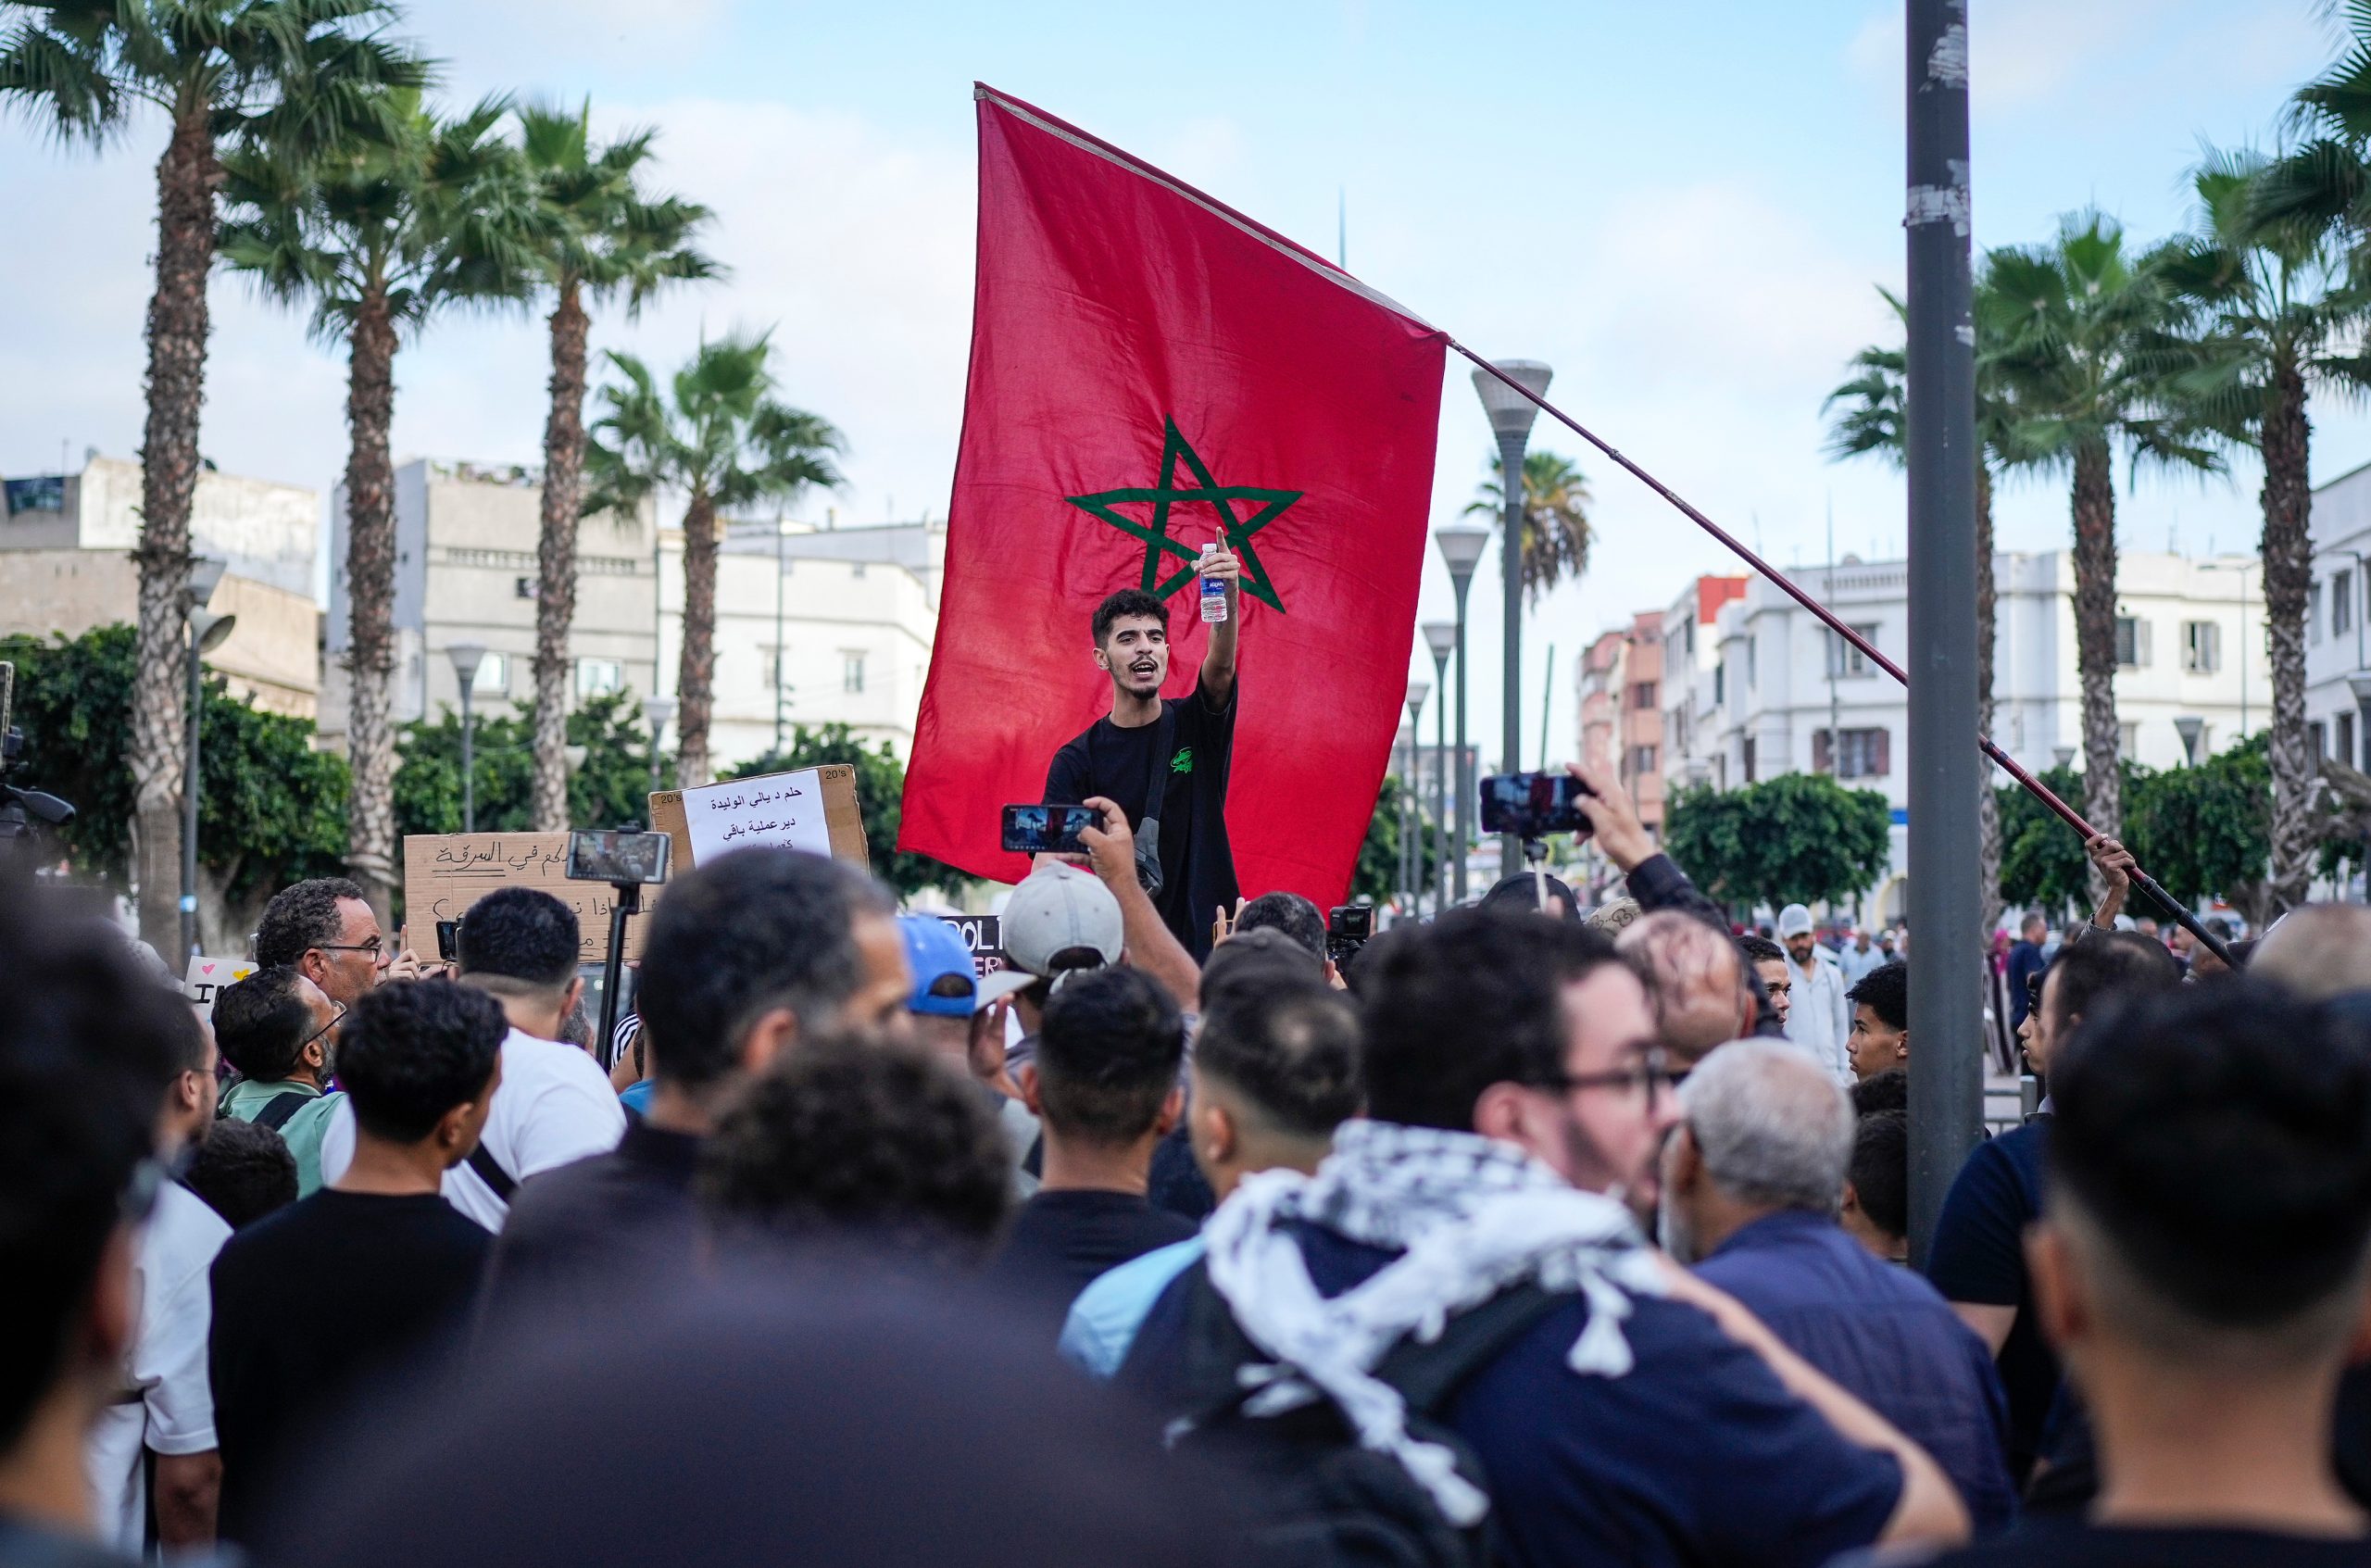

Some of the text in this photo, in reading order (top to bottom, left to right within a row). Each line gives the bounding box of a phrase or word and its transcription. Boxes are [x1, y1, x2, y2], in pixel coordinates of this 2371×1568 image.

[825, 769, 847, 780] 20's
[660, 794, 683, 804] 20's
[784, 786, 802, 802] حلم
[710, 795, 745, 810] الوليدة
[722, 823, 746, 842] باقي
[436, 841, 501, 871] السرقة
[508, 846, 537, 871] في
